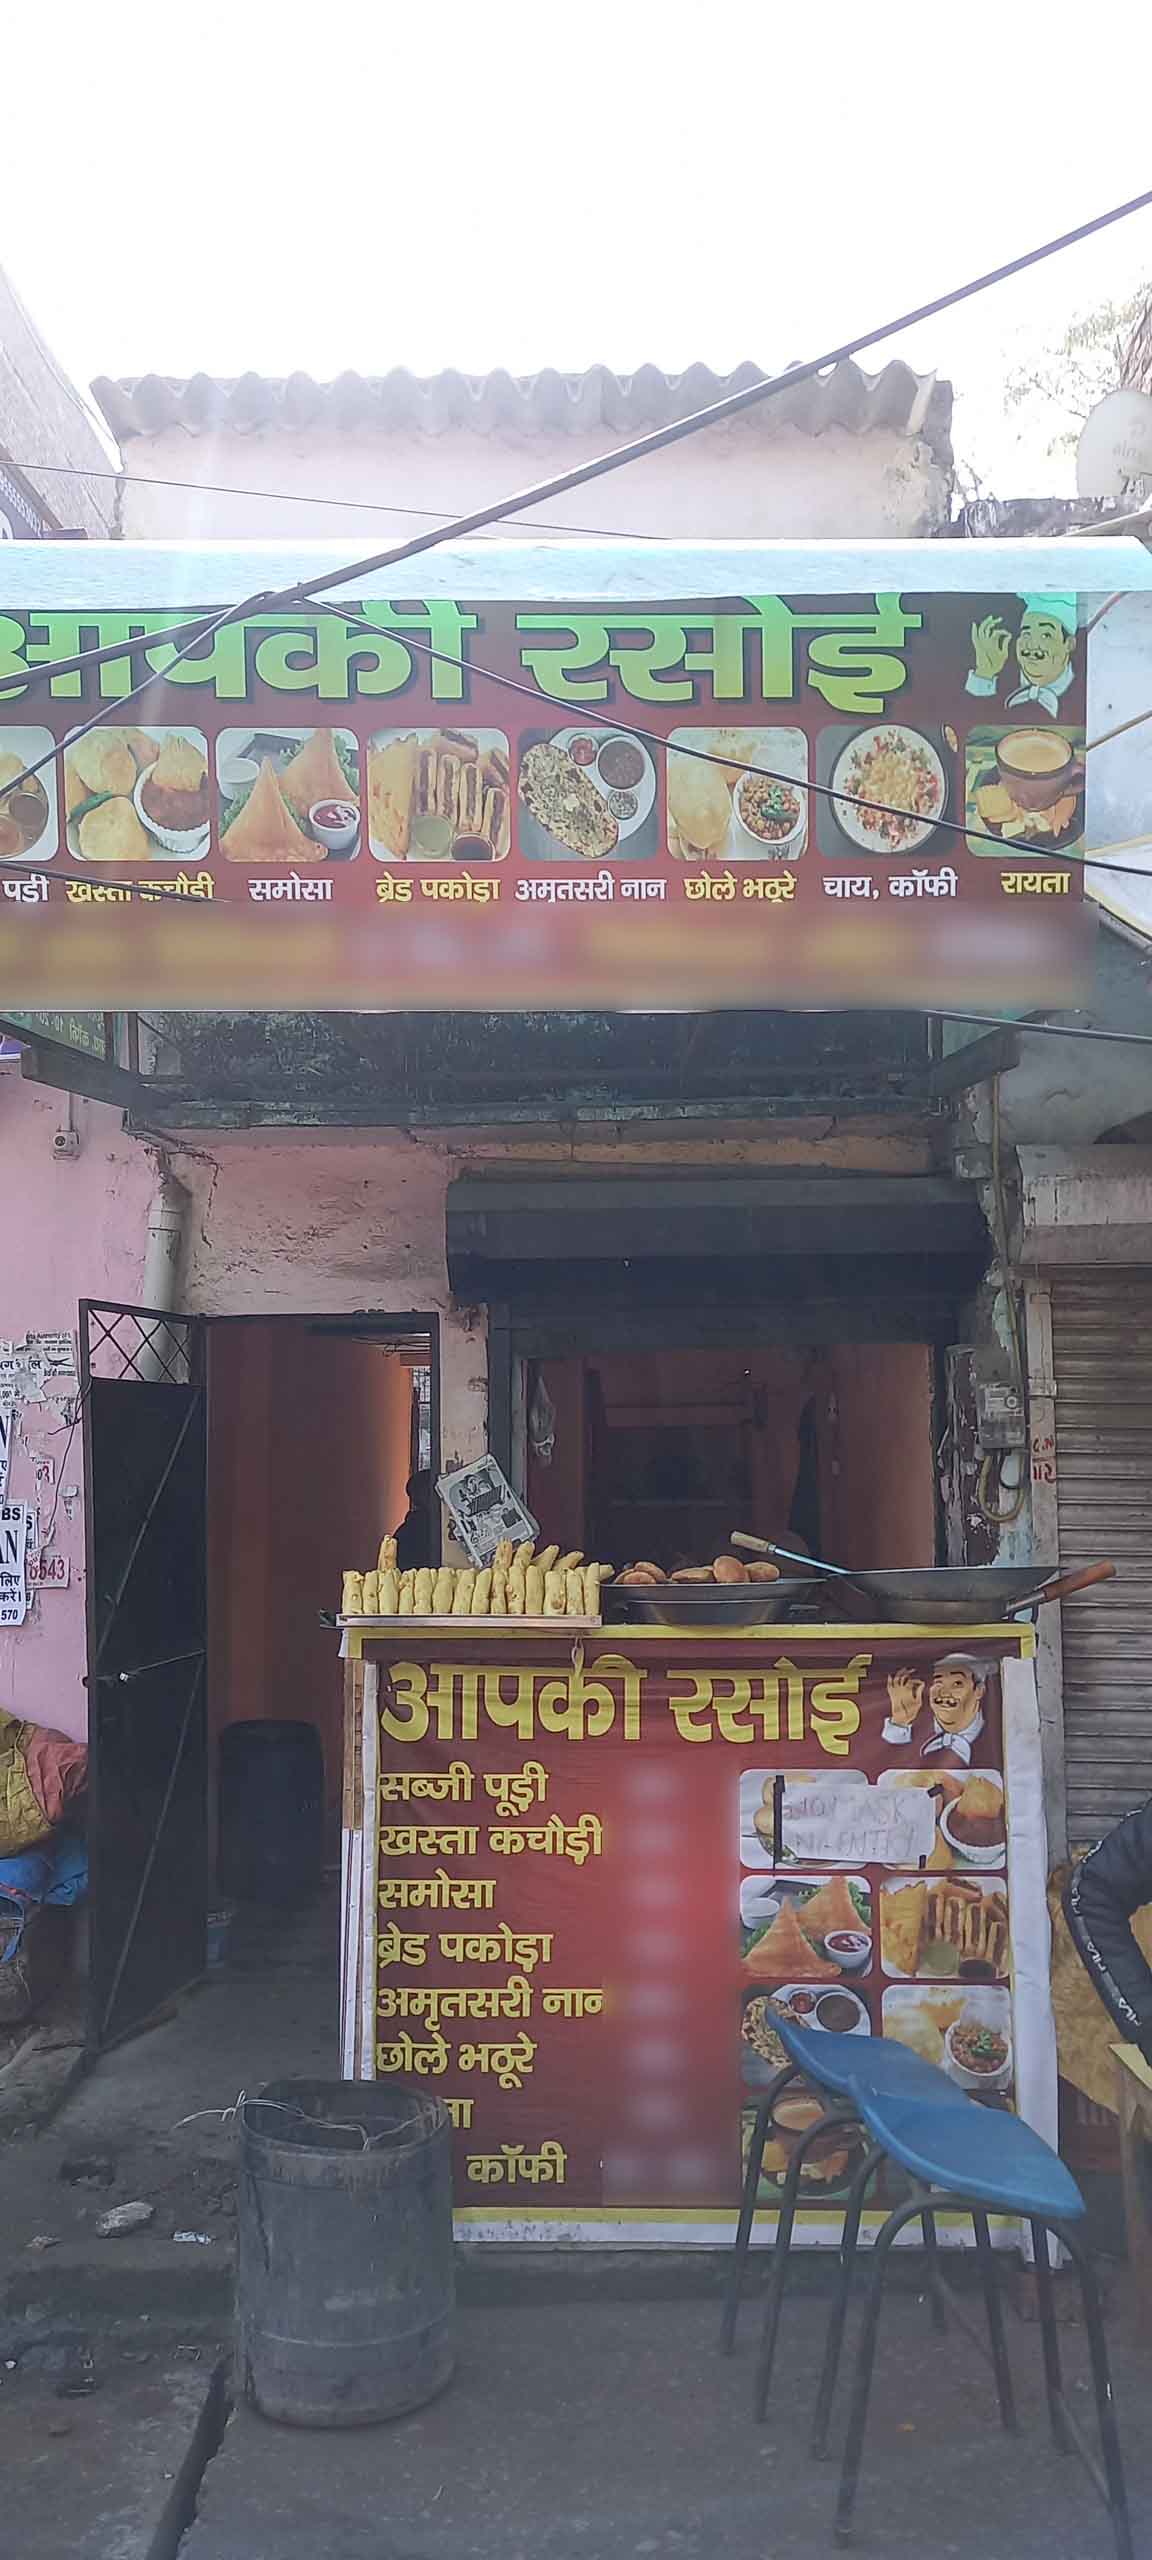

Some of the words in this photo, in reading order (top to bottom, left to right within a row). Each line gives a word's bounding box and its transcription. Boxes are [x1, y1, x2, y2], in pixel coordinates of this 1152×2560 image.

[0, 600, 478, 702] आपकी
[516, 592, 923, 715] रसोई
[247, 872, 334, 901] समोसा
[375, 871, 414, 903] ब्रेड
[620, 879, 667, 900] नान
[683, 870, 738, 900] छोले
[822, 876, 880, 900] चाय,
[888, 867, 958, 897] कॉफी
[1000, 870, 1071, 895] रायता
[381, 1654, 648, 1742] आपकी
[667, 1654, 873, 1755] रसोई
[379, 1761, 475, 1802] सब्जी
[483, 1761, 549, 1817] पूड़ी
[379, 1825, 480, 1857] खस्ता
[487, 1814, 603, 1866] कचौड़ी
[378, 1868, 497, 1909] समोसा
[377, 1922, 430, 1968] ब्रेड
[438, 1922, 554, 1973] पकोड़ा
[376, 1975, 533, 2032] अमृतसरी
[376, 2031, 452, 2075] छोले
[458, 2031, 538, 2090] भठूरे
[466, 2141, 568, 2184] कॉफी
